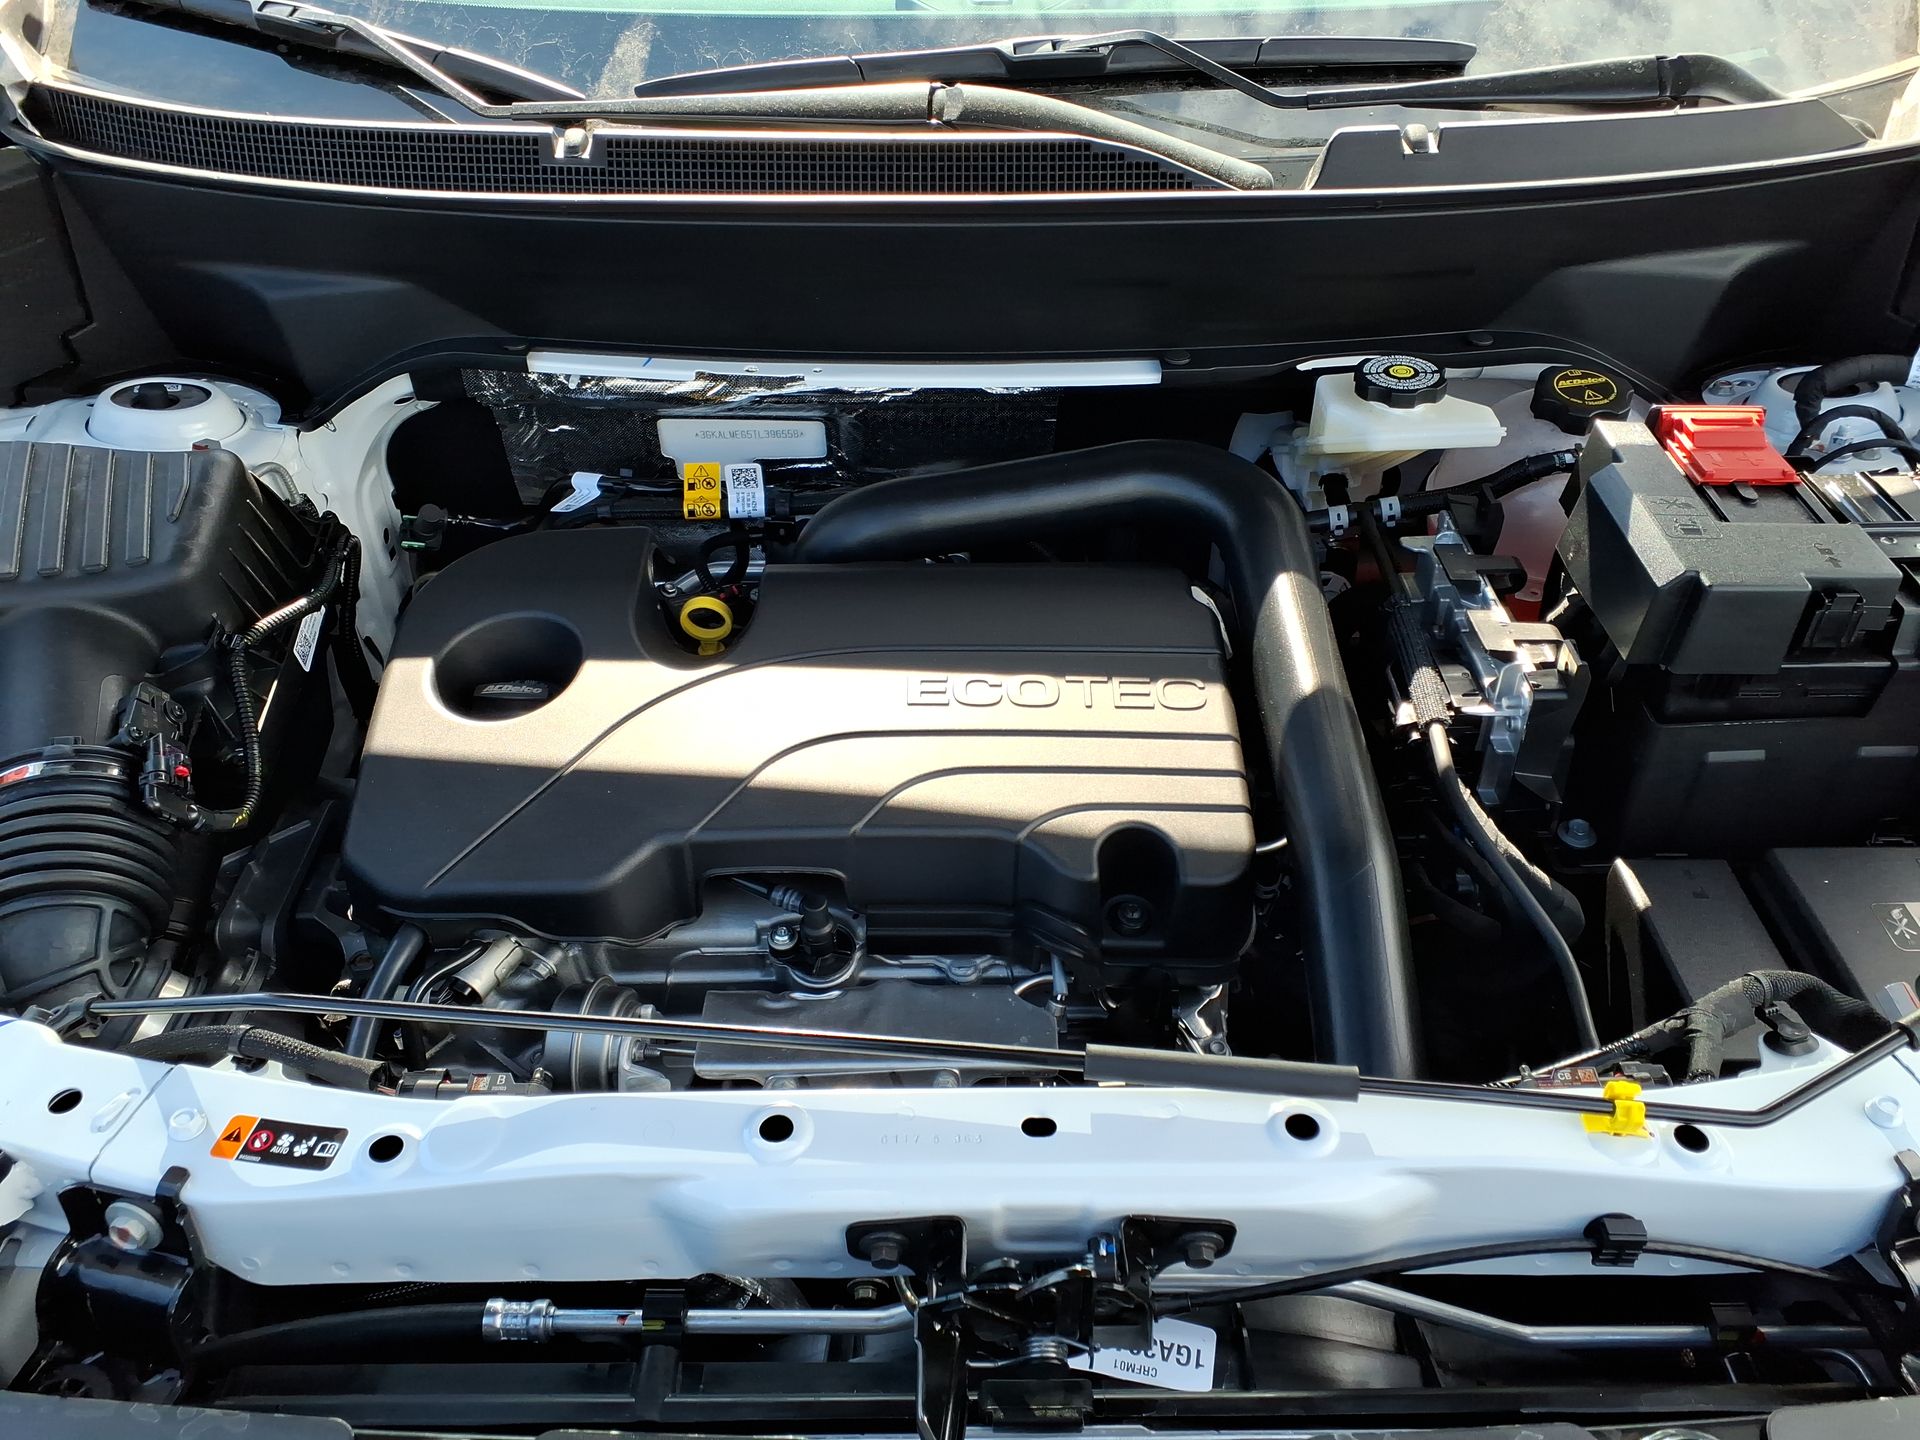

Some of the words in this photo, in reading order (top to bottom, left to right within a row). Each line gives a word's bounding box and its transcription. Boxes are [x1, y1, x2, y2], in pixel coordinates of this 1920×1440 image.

[1558, 377, 1606, 388] ACDelco
[481, 684, 543, 694] ACDelco
[907, 675, 1207, 711] ECOTEC
[497, 1074, 506, 1085] B
[1557, 1072, 1571, 1080] CB
[270, 1146, 290, 1154] AUTO
[1113, 1358, 1158, 1378] CRFM01
